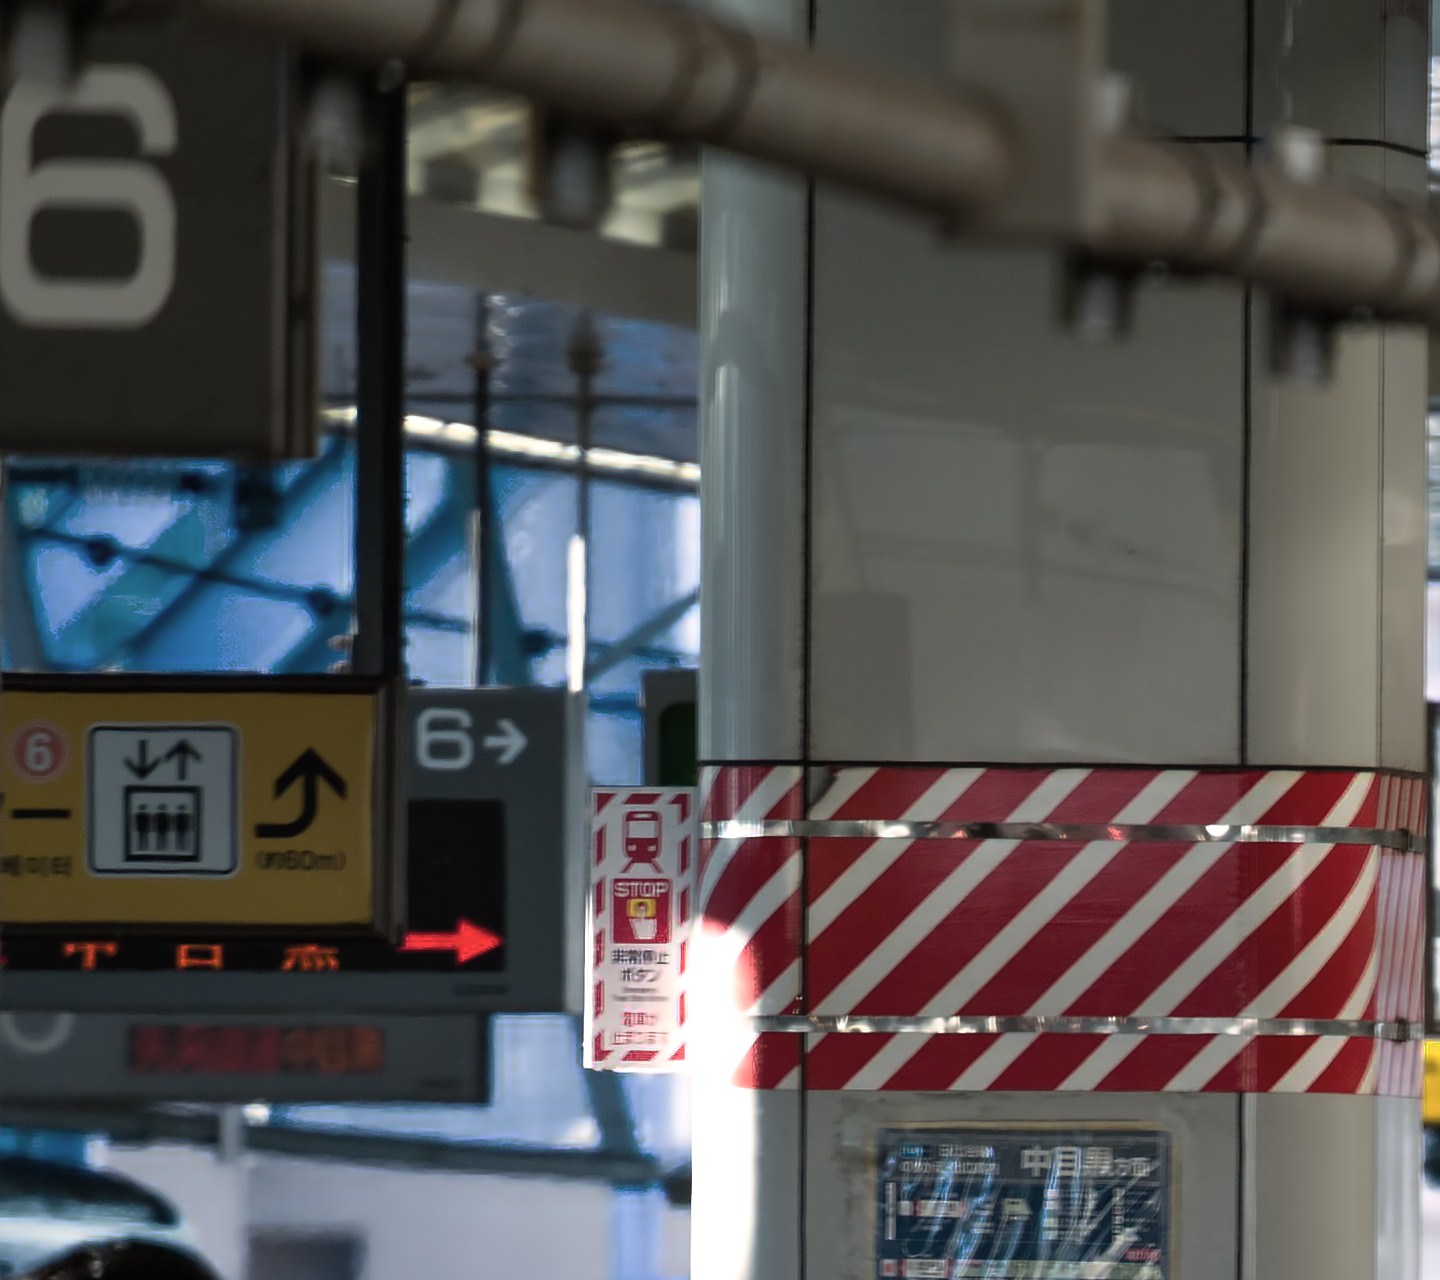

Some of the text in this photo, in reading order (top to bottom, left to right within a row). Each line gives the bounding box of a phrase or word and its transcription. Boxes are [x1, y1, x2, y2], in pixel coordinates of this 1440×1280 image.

[0, 62, 178, 330] 6
[24, 731, 52, 773] 6
[415, 707, 475, 771] 6
[614, 881, 669, 898] STOP
